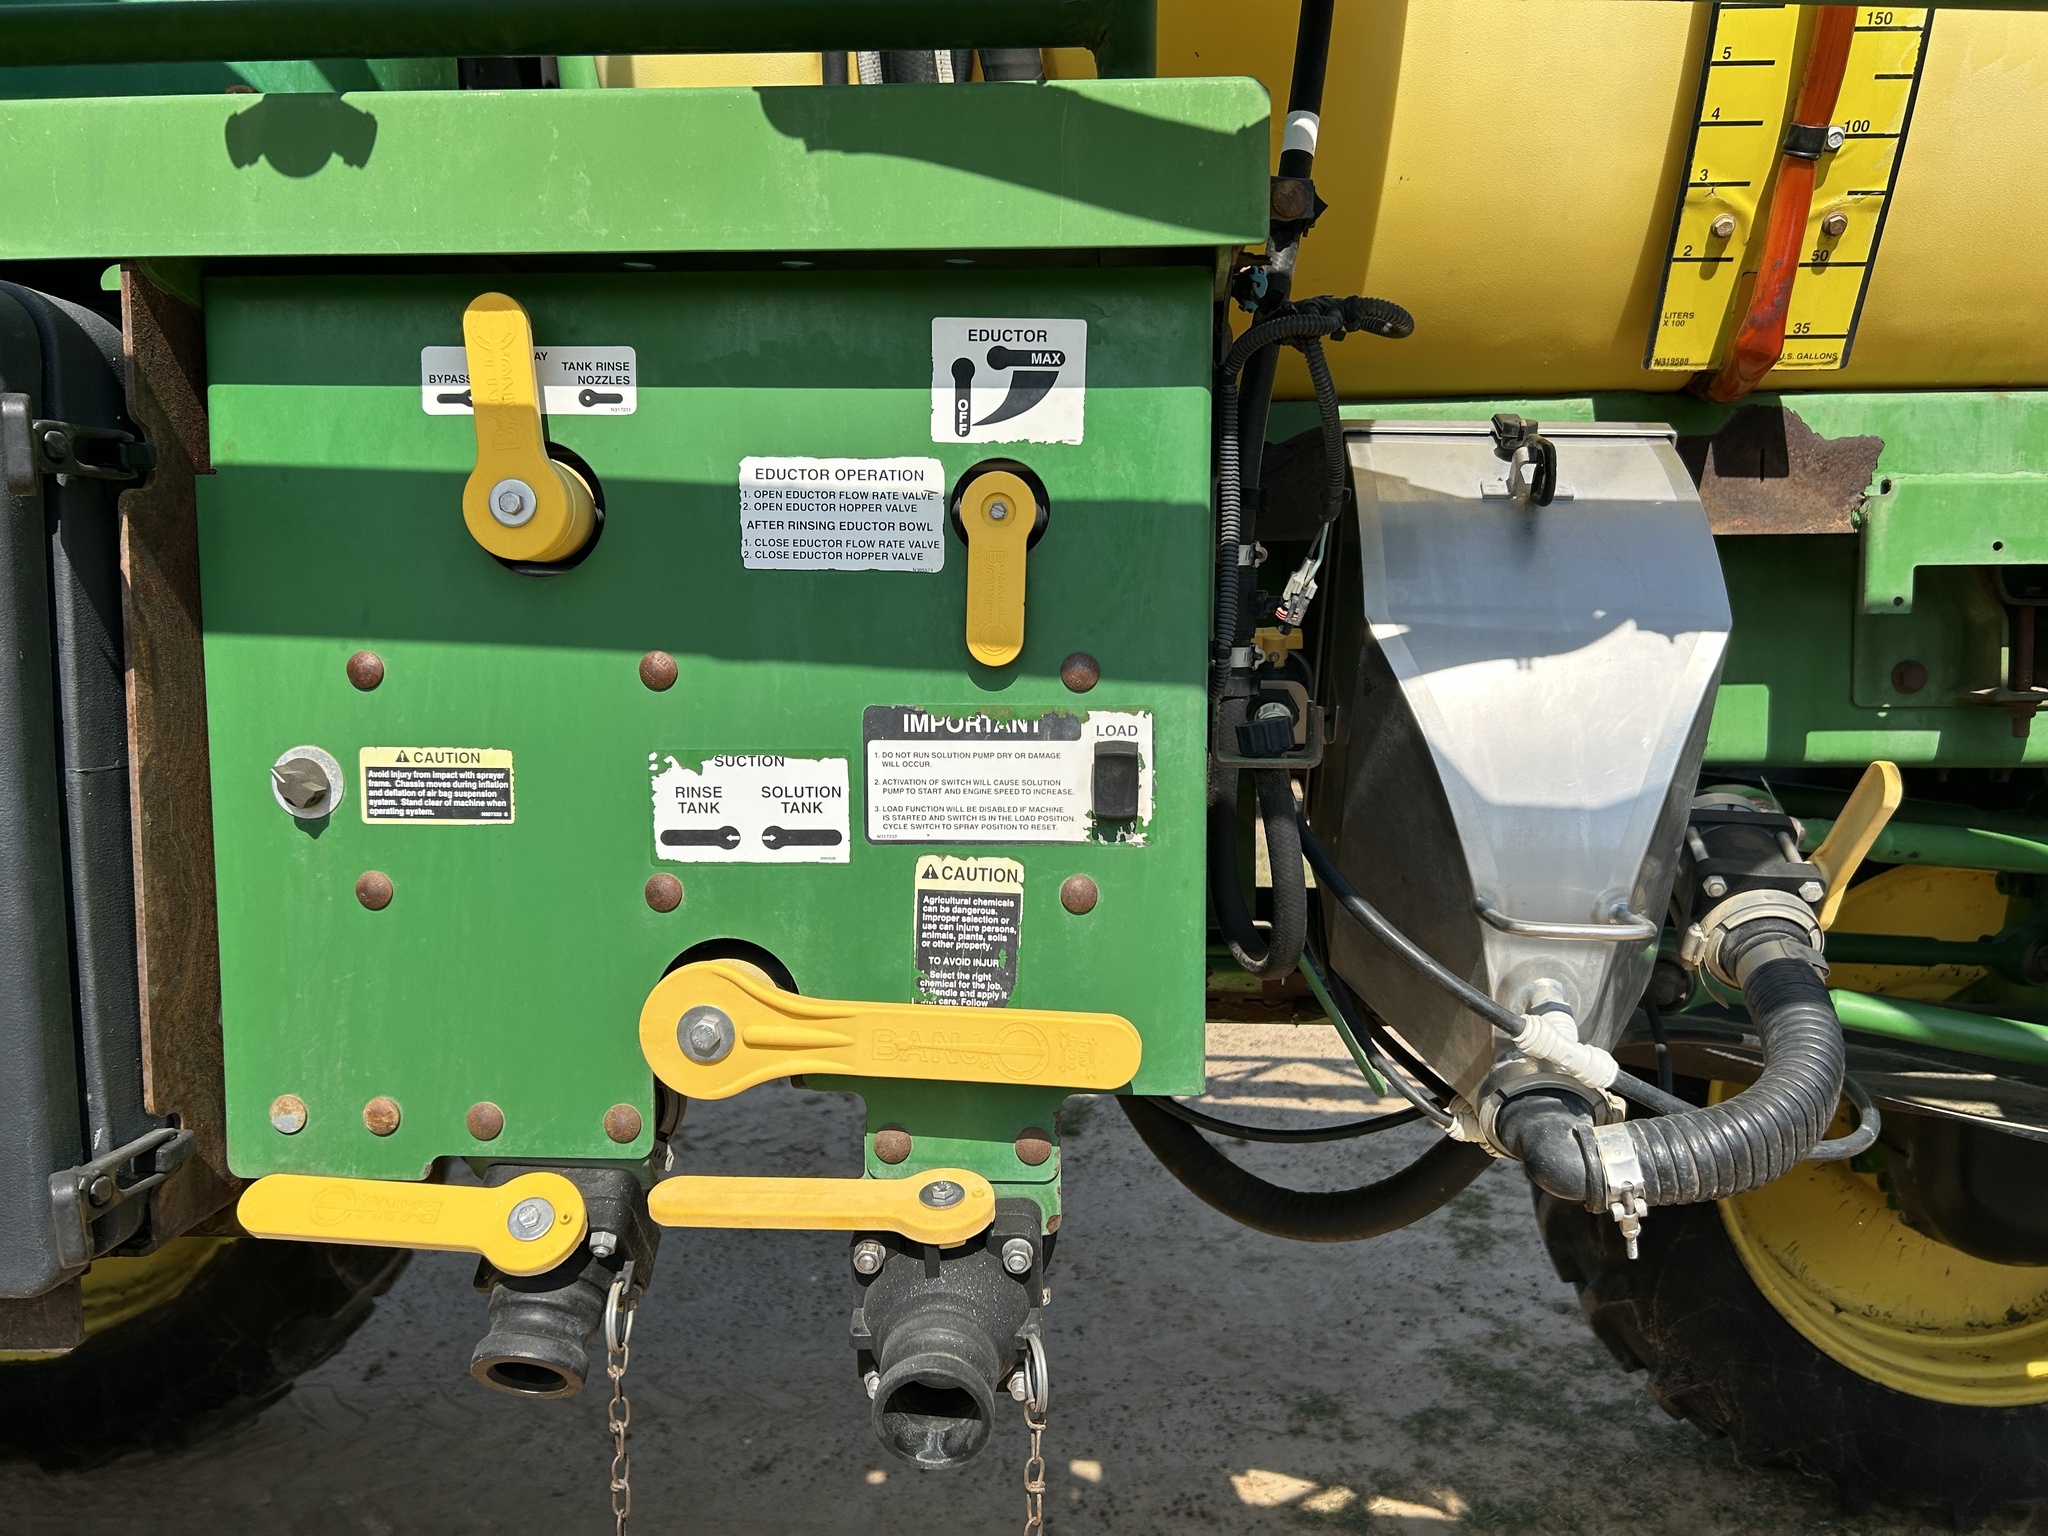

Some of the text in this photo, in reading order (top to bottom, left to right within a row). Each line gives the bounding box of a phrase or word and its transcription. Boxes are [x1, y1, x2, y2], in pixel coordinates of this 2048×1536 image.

[1867, 12, 1893, 25] 150
[1723, 47, 1732, 60] 5
[1711, 107, 1720, 120] 4
[1845, 120, 1870, 133] 100
[1700, 169, 1708, 181] 3
[1683, 245, 1692, 256] 2
[1811, 250, 1829, 263] 50
[1793, 323, 1811, 334] 35
[968, 329, 1047, 342] EDUCTOR
[534, 352, 548, 361] AY
[1031, 353, 1061, 364] MAX
[1796, 352, 1838, 361] GALLONS
[562, 362, 630, 371] TANK RINSE
[429, 374, 470, 384] BYPASS
[578, 375, 630, 385] NOZZLES
[756, 468, 924, 481] EDUCTOR OPERATION
[754, 490, 934, 501] OPEN EDUCTOR FLOW RATE VALVE
[754, 502, 917, 513] OPEN EDUCTOR HOPPER VALVE
[747, 520, 933, 532] AFTER RINSING EDUCTOR BOWL
[755, 538, 940, 549] CLOSE EDUCTOR FLOW RATE VALVE
[755, 551, 923, 561] CLOSE EDUCTOR HOPPER VALVE
[1097, 725, 1138, 736] LOAD
[414, 752, 480, 764] CAUTION
[714, 756, 785, 767] SUCTION
[368, 770, 505, 781] Avoid injury from impact with sprayer
[368, 779, 392, 787] frame.
[395, 780, 425, 788] Chassis
[452, 780, 477, 790] during
[478, 780, 509, 790] inflation
[384, 789, 497, 799] deflation bag suspension
[676, 786, 722, 798] RINSE
[762, 786, 841, 798] SOLUTION
[369, 798, 507, 807] system. Stand clear machine when
[678, 802, 720, 814] TANK
[781, 802, 823, 814] TANK
[369, 807, 435, 817] operating system.
[942, 866, 1018, 883] CAUTION
[923, 895, 1014, 907] Agricultural chemicals
[940, 905, 950, 913] be
[952, 906, 998, 917] dangerous.
[923, 913, 999, 925] Improper selection
[956, 923, 980, 934] injure
[982, 926, 1017, 935] persons,
[922, 931, 1007, 942] animals, plants, soils
[932, 940, 993, 952] other property.
[928, 957, 999, 968] TO AVOID INJUR
[930, 969, 992, 983] Select the right
[920, 979, 957, 989] chemical
[958, 980, 971, 989] for
[972, 981, 986, 989] the
[977, 990, 1000, 1001] apply
[939, 998, 959, 1006] care.
[961, 998, 990, 1007] Follow
